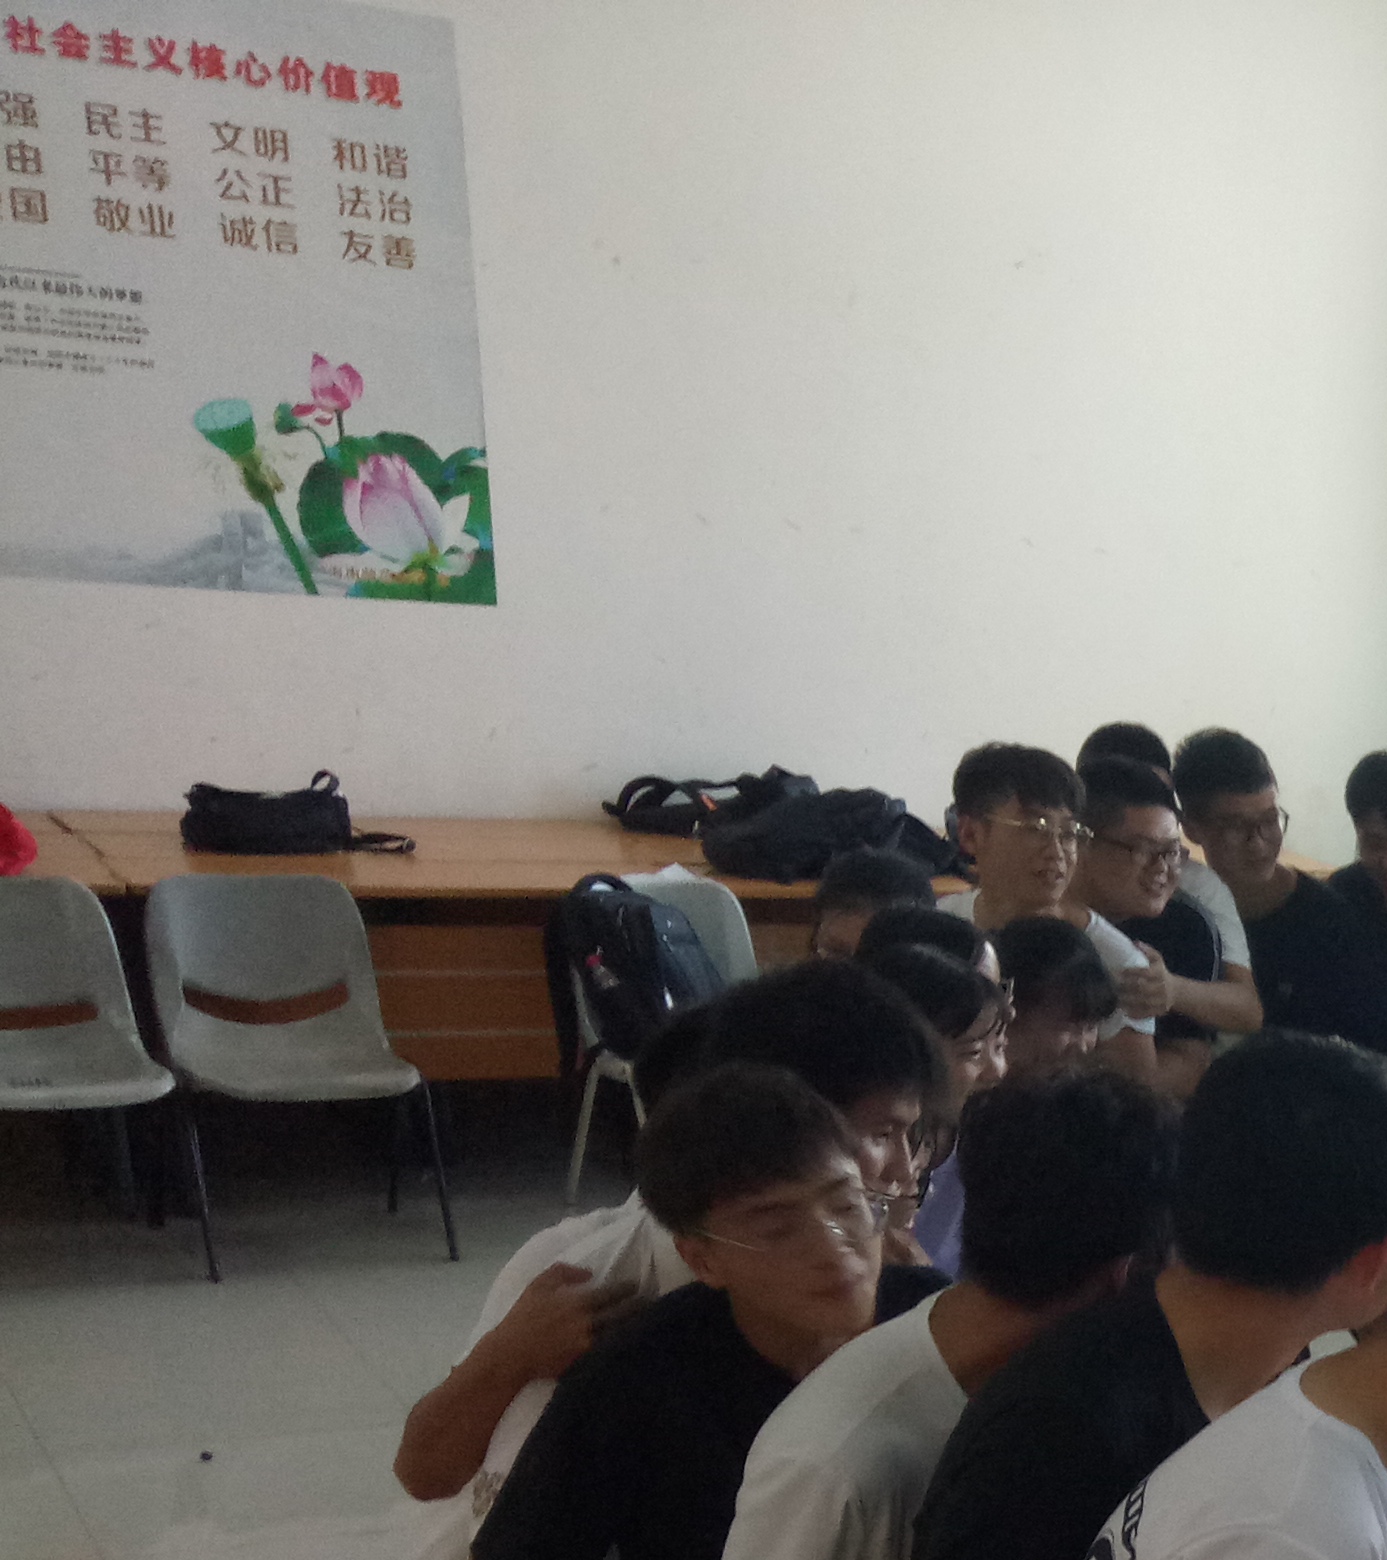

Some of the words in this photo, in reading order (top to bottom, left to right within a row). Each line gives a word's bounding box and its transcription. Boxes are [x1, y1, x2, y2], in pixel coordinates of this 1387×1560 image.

[3, 14, 402, 109] 社会主义核心价值观
[85, 101, 167, 145] 民主
[209, 121, 292, 163] 文明
[331, 137, 409, 180] 和谐
[6, 139, 43, 175] 由
[89, 149, 171, 192] 平等
[214, 168, 297, 209] 公正
[336, 183, 413, 225] 法治
[93, 195, 177, 238] 敬业
[218, 212, 299, 255] 诚信
[341, 229, 416, 270] 友善
